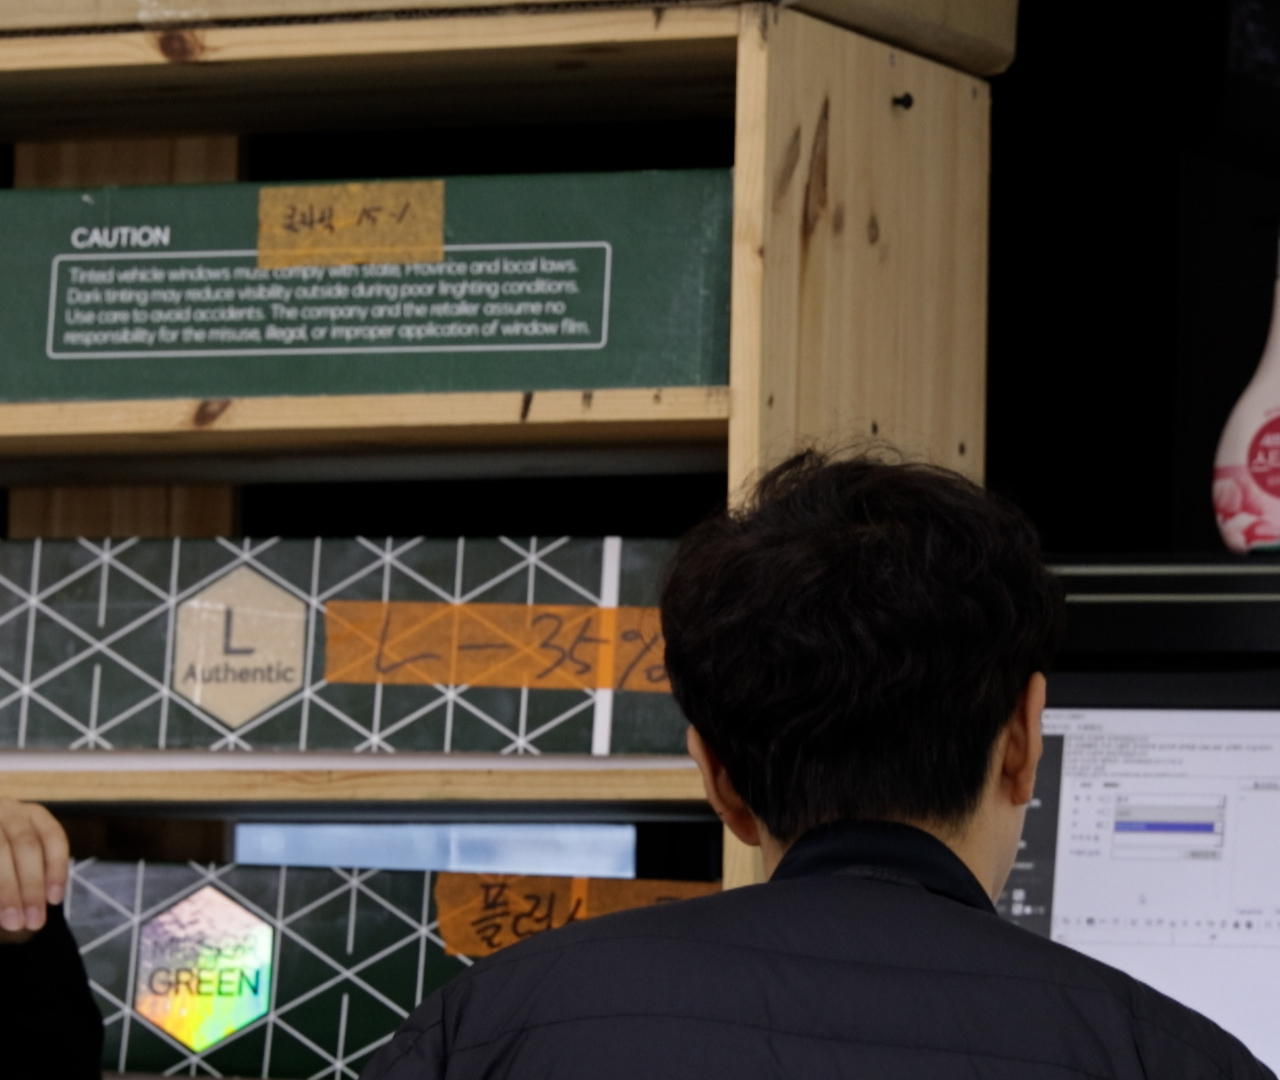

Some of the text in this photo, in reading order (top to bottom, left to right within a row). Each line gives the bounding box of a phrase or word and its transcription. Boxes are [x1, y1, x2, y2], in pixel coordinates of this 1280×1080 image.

[70, 226, 170, 248] CAUTION
[70, 267, 114, 284] Tinted
[117, 267, 165, 283] vehicle
[168, 265, 231, 281] windows
[470, 258, 500, 275] and
[503, 257, 537, 274] local
[540, 257, 578, 273] laws.
[66, 289, 103, 306] Dark
[104, 288, 149, 307] tinting
[150, 290, 183, 306] may
[184, 286, 236, 302] reduce
[237, 284, 292, 303] visibility
[294, 282, 349, 300] outside
[351, 280, 399, 301] during
[400, 282, 436, 300] poor
[501, 277, 579, 295] conditions.
[65, 300, 566, 325] Use care to avoid accidents. The company and the retailer assume no
[63, 317, 591, 347] responsibility for the misuse, illegal, or improper application of window film.
[223, 605, 257, 658] L
[182, 660, 296, 687] Authentic
[148, 967, 260, 997] GREEN
